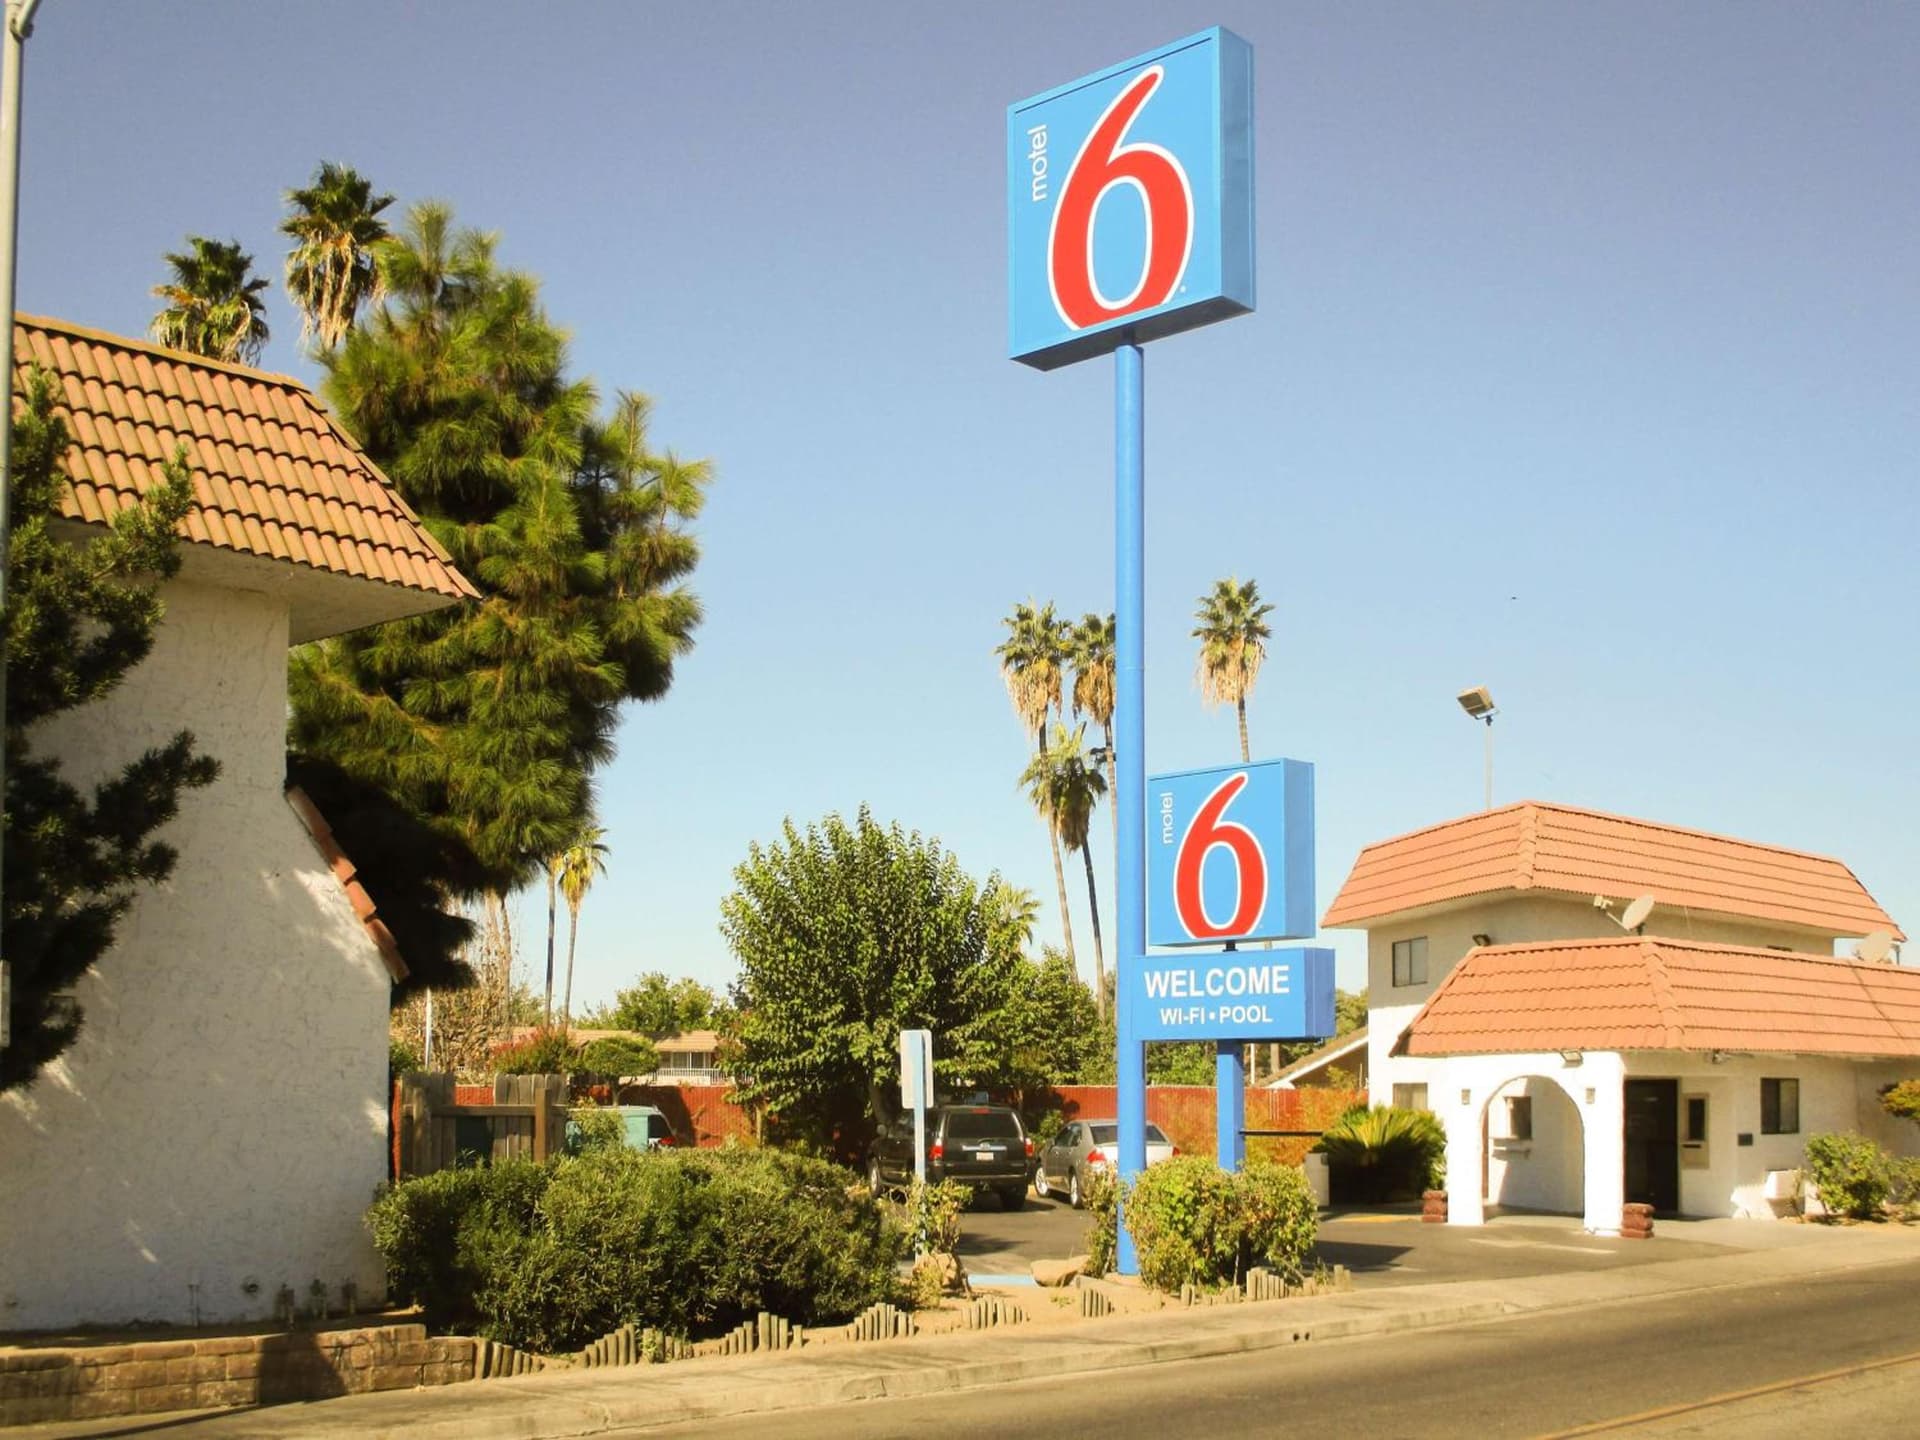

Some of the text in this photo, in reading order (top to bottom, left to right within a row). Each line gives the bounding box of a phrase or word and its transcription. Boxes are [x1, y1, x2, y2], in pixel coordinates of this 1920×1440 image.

[1028, 124, 1047, 202] motel
[1047, 64, 1194, 331] 6
[1160, 792, 1173, 844] motel
[1173, 771, 1268, 939] 6
[1143, 965, 1290, 998] WELCOME
[1160, 1005, 1273, 1025] WI-FI POOL
